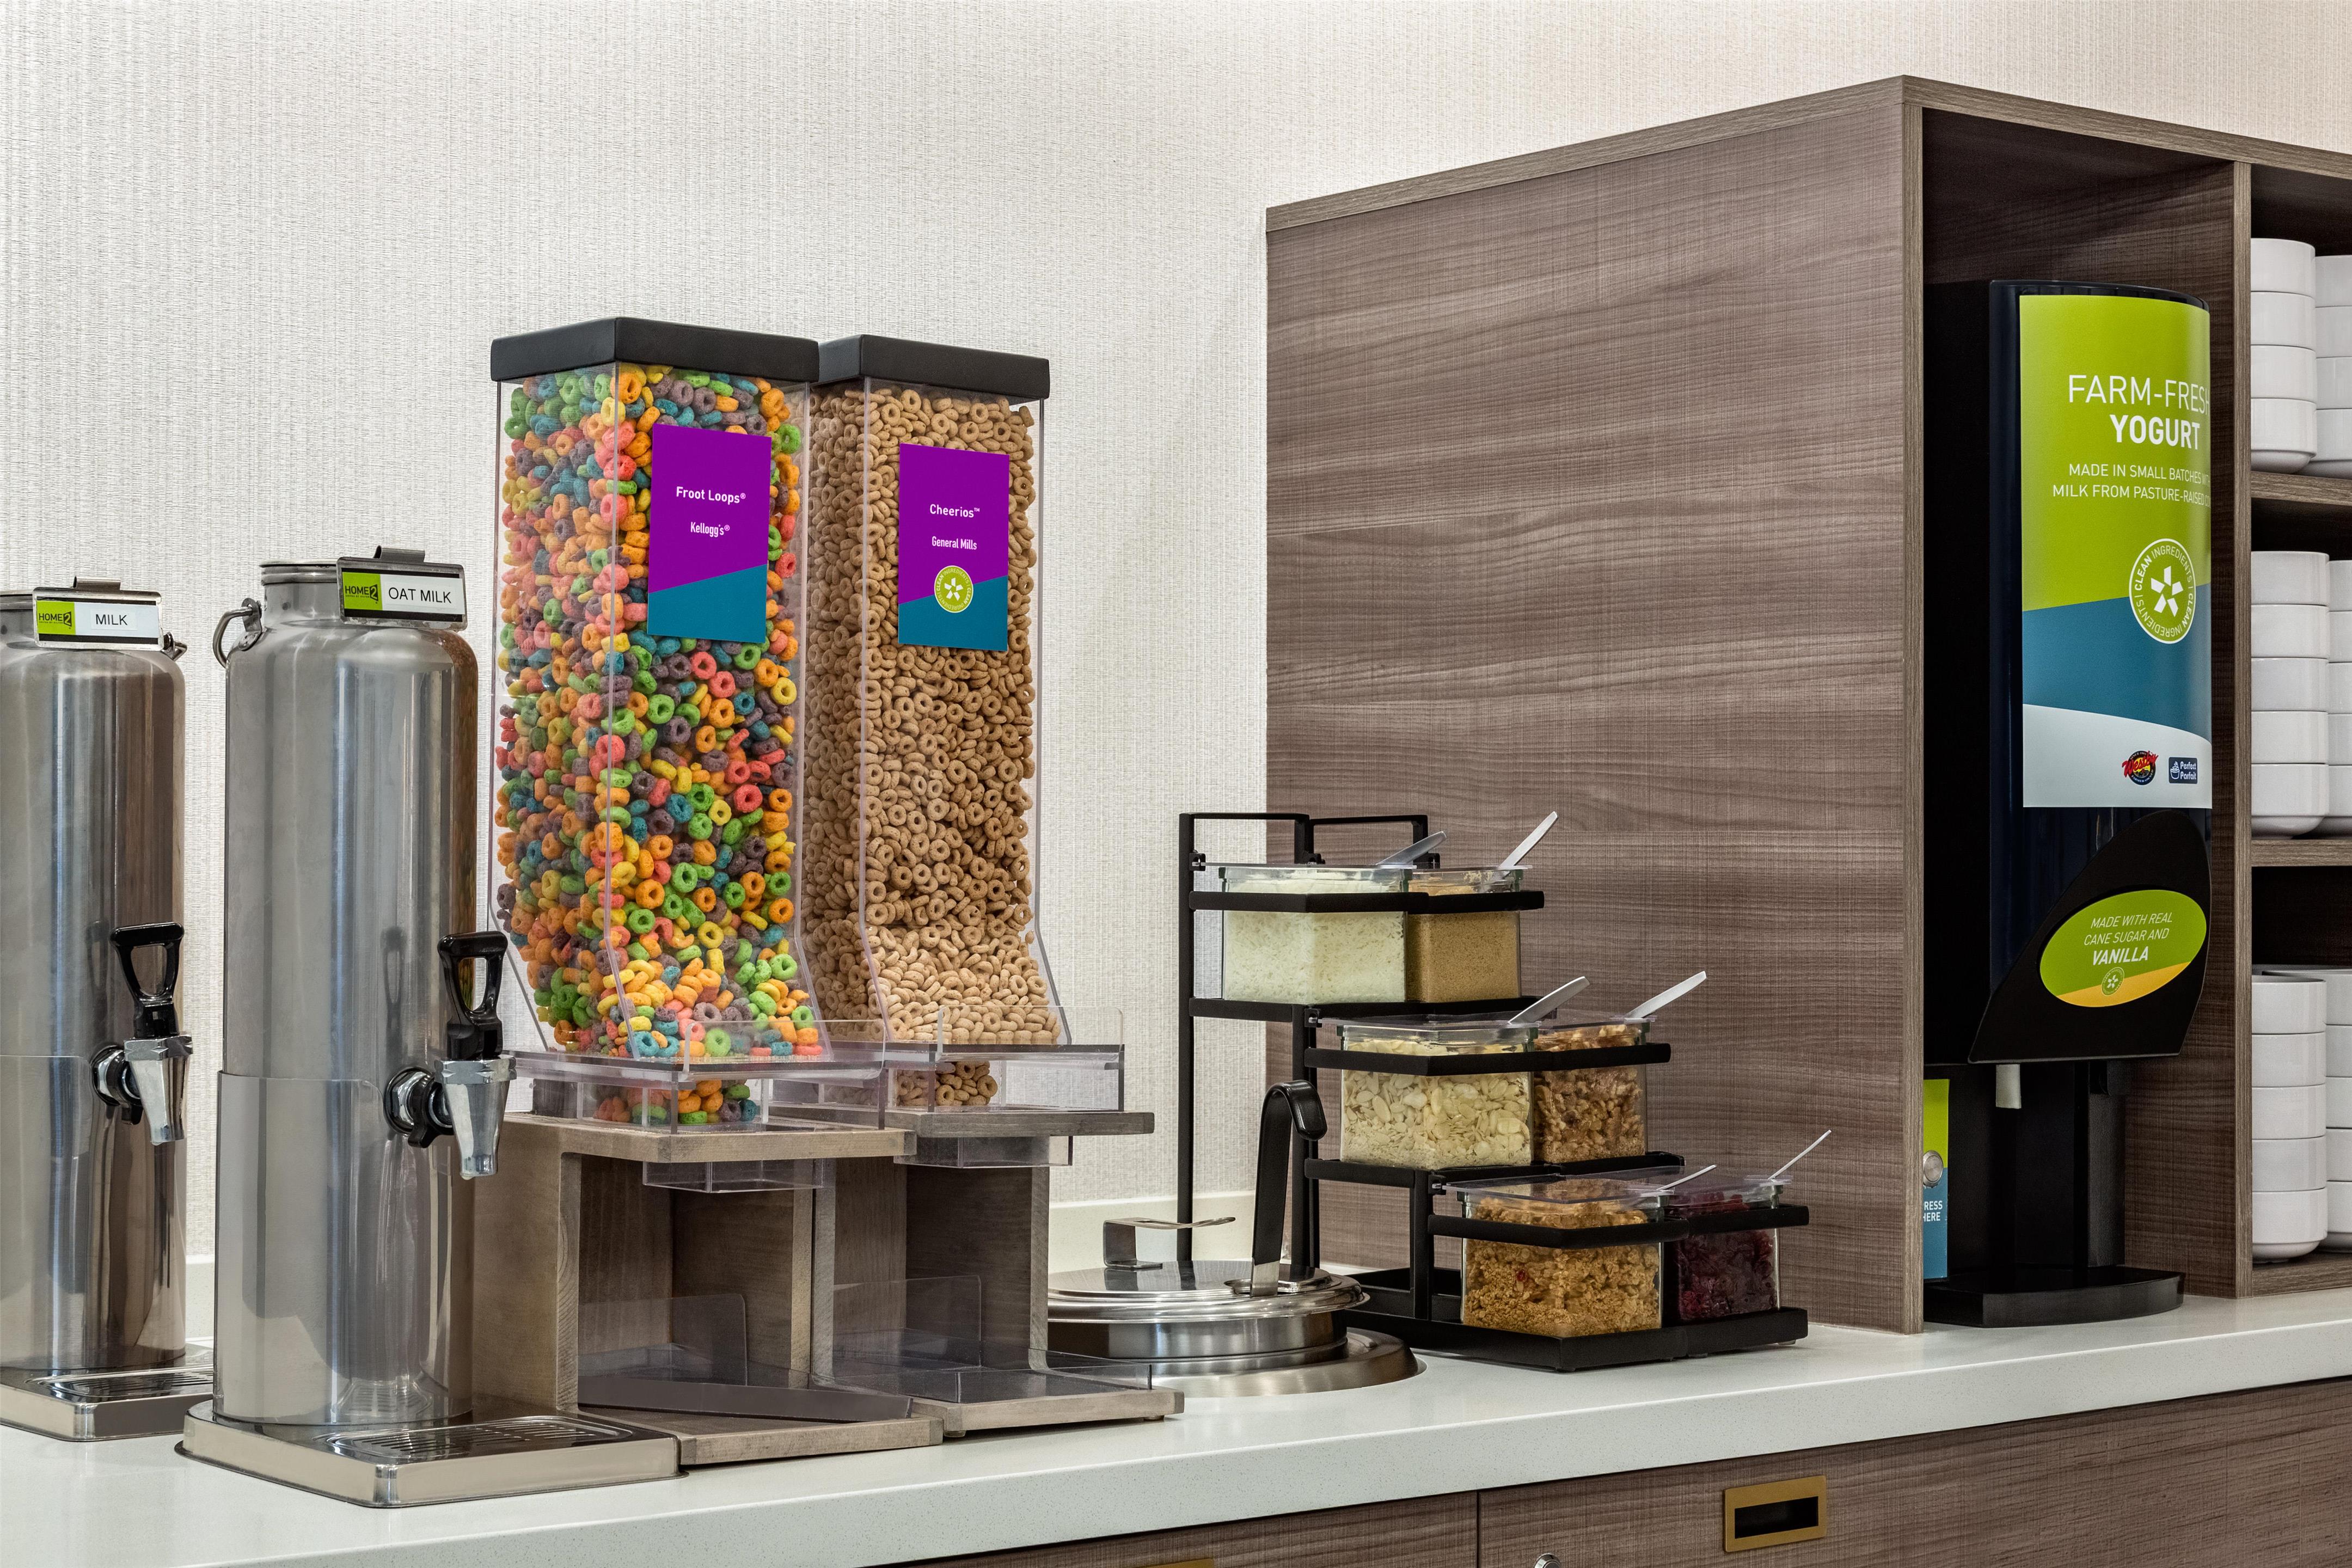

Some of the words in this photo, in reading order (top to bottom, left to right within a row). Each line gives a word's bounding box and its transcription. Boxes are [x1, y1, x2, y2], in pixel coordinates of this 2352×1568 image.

[2109, 414, 2200, 450] YOGURT
[2069, 464, 2109, 476] MADE
[2113, 464, 2126, 477] IN
[2130, 465, 2167, 479] SMALL
[2169, 468, 2201, 484] BATCHES
[676, 486, 705, 500] Froot
[2053, 485, 2088, 497] MILK
[2093, 485, 2129, 498] FROM
[2134, 486, 2204, 506] PASTURE-RAISED
[932, 536, 959, 549] General
[960, 538, 977, 550] Mills
[2134, 555, 2153, 591] CLEAN
[2151, 544, 2193, 583] INGREDIENTS
[936, 574, 945, 591] CLEAN
[388, 587, 416, 601] OAT
[420, 590, 451, 604] MILK
[2136, 599, 2183, 638] INGREDIENTS
[2181, 593, 2194, 628] CLEAN
[96, 614, 128, 626] MILK
[2122, 750, 2159, 778] Westby
[2180, 761, 2197, 770] Perfect
[2180, 771, 2197, 780] Parfait
[2091, 916, 2122, 929] MADE
[2122, 914, 2148, 926] WITH
[2148, 912, 2173, 924] REAL
[2084, 933, 2113, 946] CANE
[2112, 930, 2147, 944] SUGAR
[2147, 928, 2170, 940] AND
[2092, 946, 2149, 966] VANILLA
[1924, 1200, 1943, 1210] RESS
